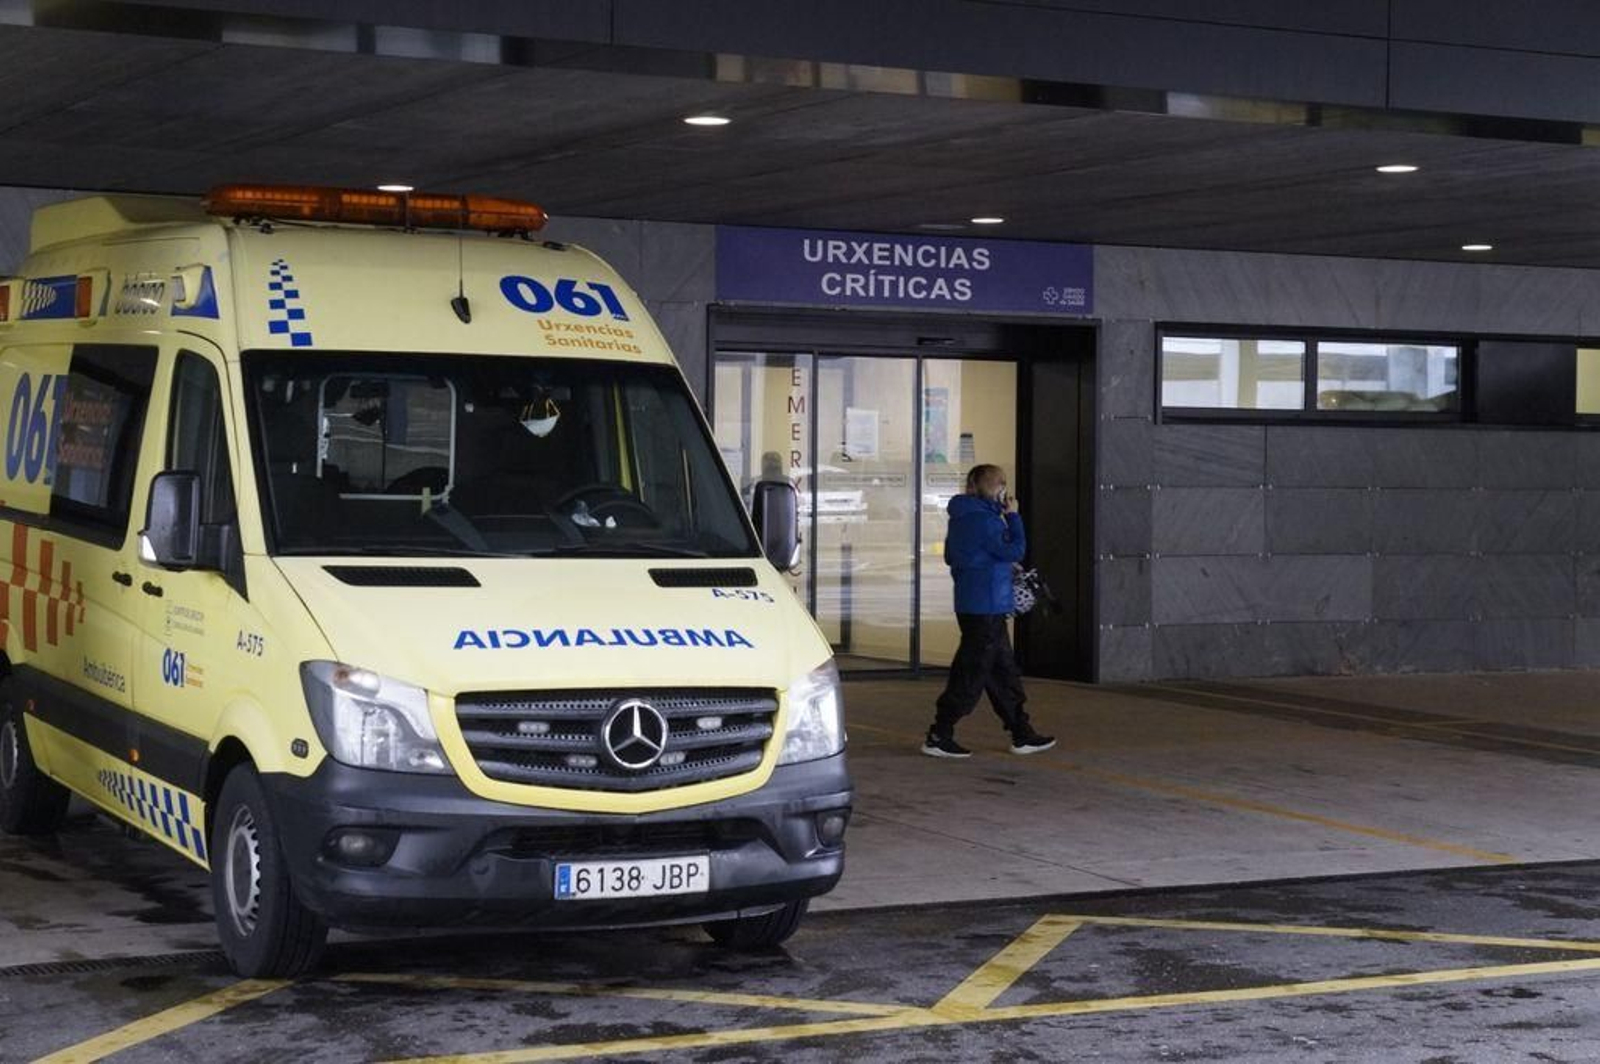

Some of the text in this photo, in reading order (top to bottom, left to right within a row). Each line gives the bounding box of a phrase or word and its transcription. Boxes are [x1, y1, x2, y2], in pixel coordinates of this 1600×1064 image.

[803, 239, 991, 270] URXENCIAS
[500, 274, 629, 321] 061
[821, 270, 972, 302] CRÍTICAS
[537, 319, 634, 339] Urxencias
[545, 335, 642, 354] Sanitarias
[6, 372, 70, 486] 061
[711, 587, 774, 603] A-575
[237, 630, 264, 657] A-575
[163, 647, 185, 687] 061
[576, 863, 699, 893] 6138 JBP
